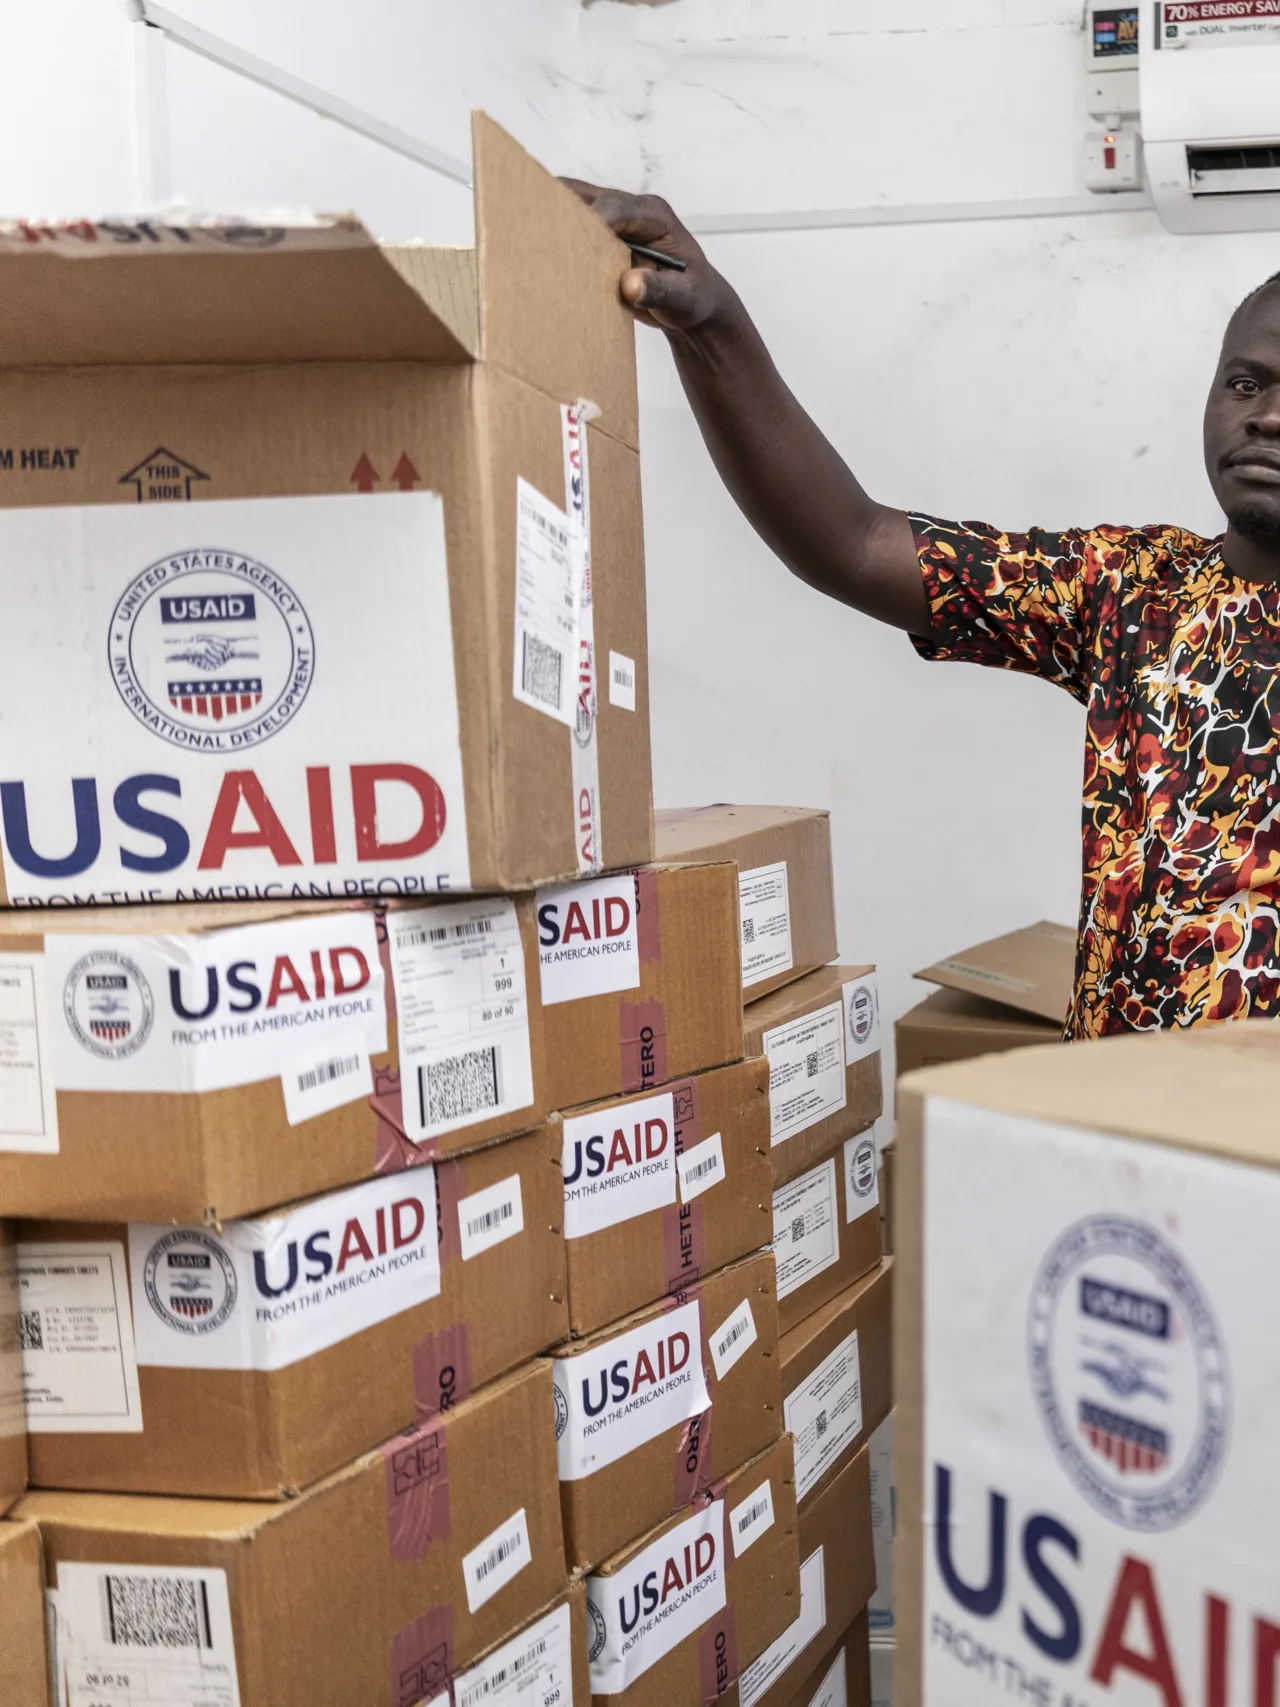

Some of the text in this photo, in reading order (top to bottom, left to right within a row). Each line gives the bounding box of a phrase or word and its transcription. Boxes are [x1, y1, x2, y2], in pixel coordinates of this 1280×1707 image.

[1166, 4, 1200, 21] 70%
[1201, 1, 1253, 18] ENERGY
[1200, 25, 1226, 35] DUAL
[1229, 22, 1268, 34] Inverter
[20, 449, 79, 470] HEAT
[149, 465, 180, 479] THIS
[149, 486, 181, 499] SIDE
[118, 554, 299, 623] UNITED STATES AGENCY
[169, 598, 245, 619] USAID
[114, 646, 310, 749] INTERNATIONAL DEVELOPMENT
[0, 762, 447, 879] USAID
[538, 896, 630, 947] SAID
[500, 958, 505, 969] 1
[554, 945, 600, 963] AMERICAN
[602, 940, 632, 954] PEOPLE
[168, 946, 371, 1022] USAID
[495, 979, 512, 992] 999
[171, 998, 374, 1046] FROM THE AMERICAN PEOPLE
[482, 1006, 514, 1021] 80 of 90
[564, 1118, 668, 1185] USAID
[581, 1182, 599, 1198] THE
[598, 1167, 642, 1192] AMERICAN
[642, 1159, 669, 1176] PEOPLE
[171, 1255, 206, 1267] USAID
[253, 1197, 425, 1299] USAID
[256, 1245, 427, 1323] FROM THE AMERICAN PEOPLE
[582, 1331, 690, 1417] USAID
[583, 1370, 692, 1438] FROM THE AMERICAN PEOPLE
[619, 1532, 715, 1635] USAID
[621, 1569, 718, 1655] FROM THE AMERICAN PEOPLE
[550, 1674, 554, 1682] 1
[931, 1612, 1055, 1707] FROM THE
[544, 1689, 561, 1706] 999
